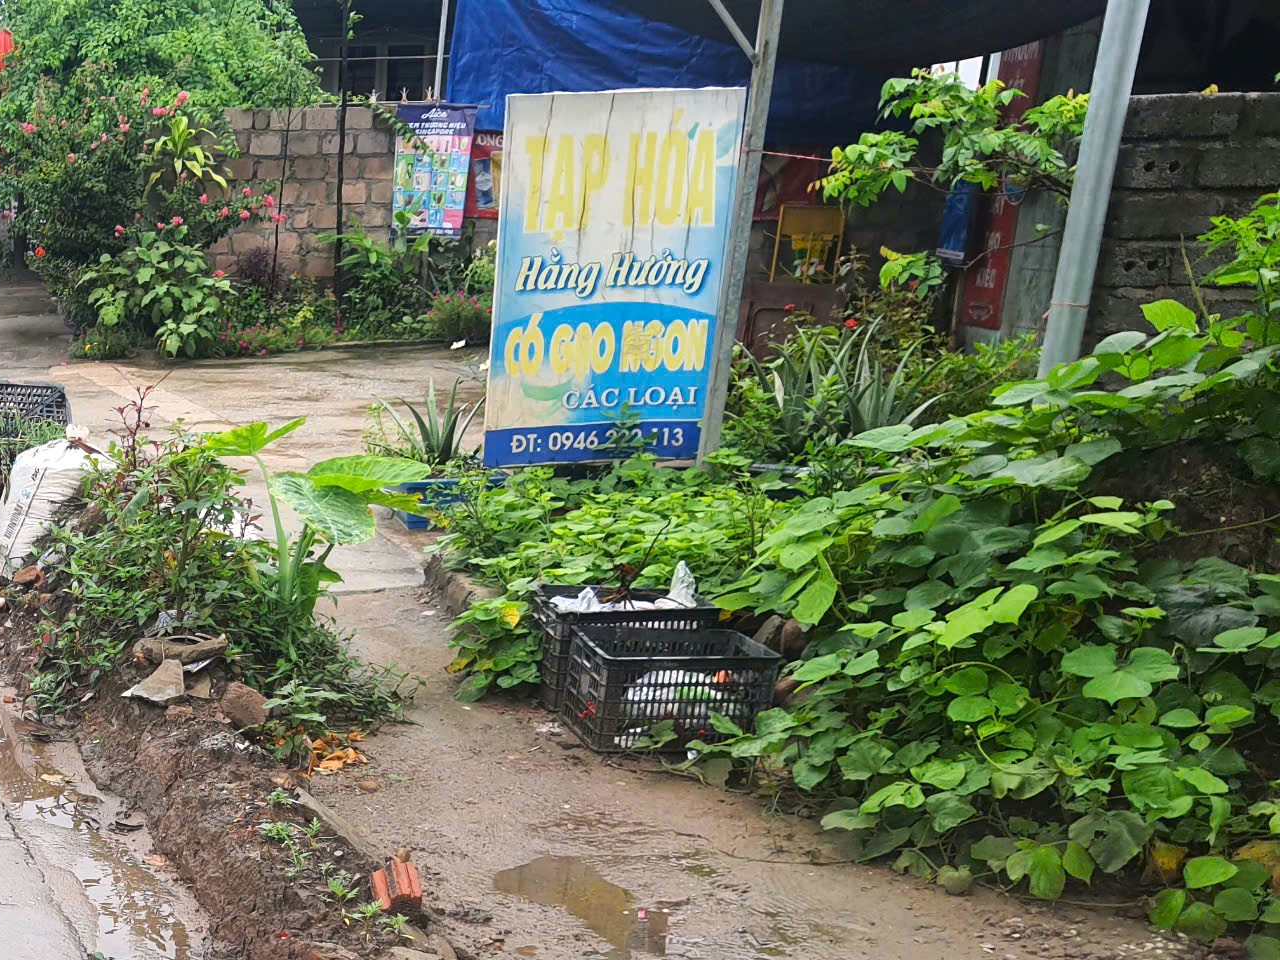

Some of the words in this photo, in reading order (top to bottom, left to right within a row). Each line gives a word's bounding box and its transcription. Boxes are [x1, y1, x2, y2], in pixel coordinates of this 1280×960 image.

[421, 108, 448, 119] Aice
[524, 133, 610, 243] TẠP
[623, 107, 715, 227] HÓA
[514, 247, 601, 299] Hằng
[503, 313, 545, 378] CÓ
[620, 319, 709, 373] NGON
[562, 384, 620, 409] CÁC
[627, 386, 699, 410] LOẠI
[510, 434, 542, 454] ĐT:
